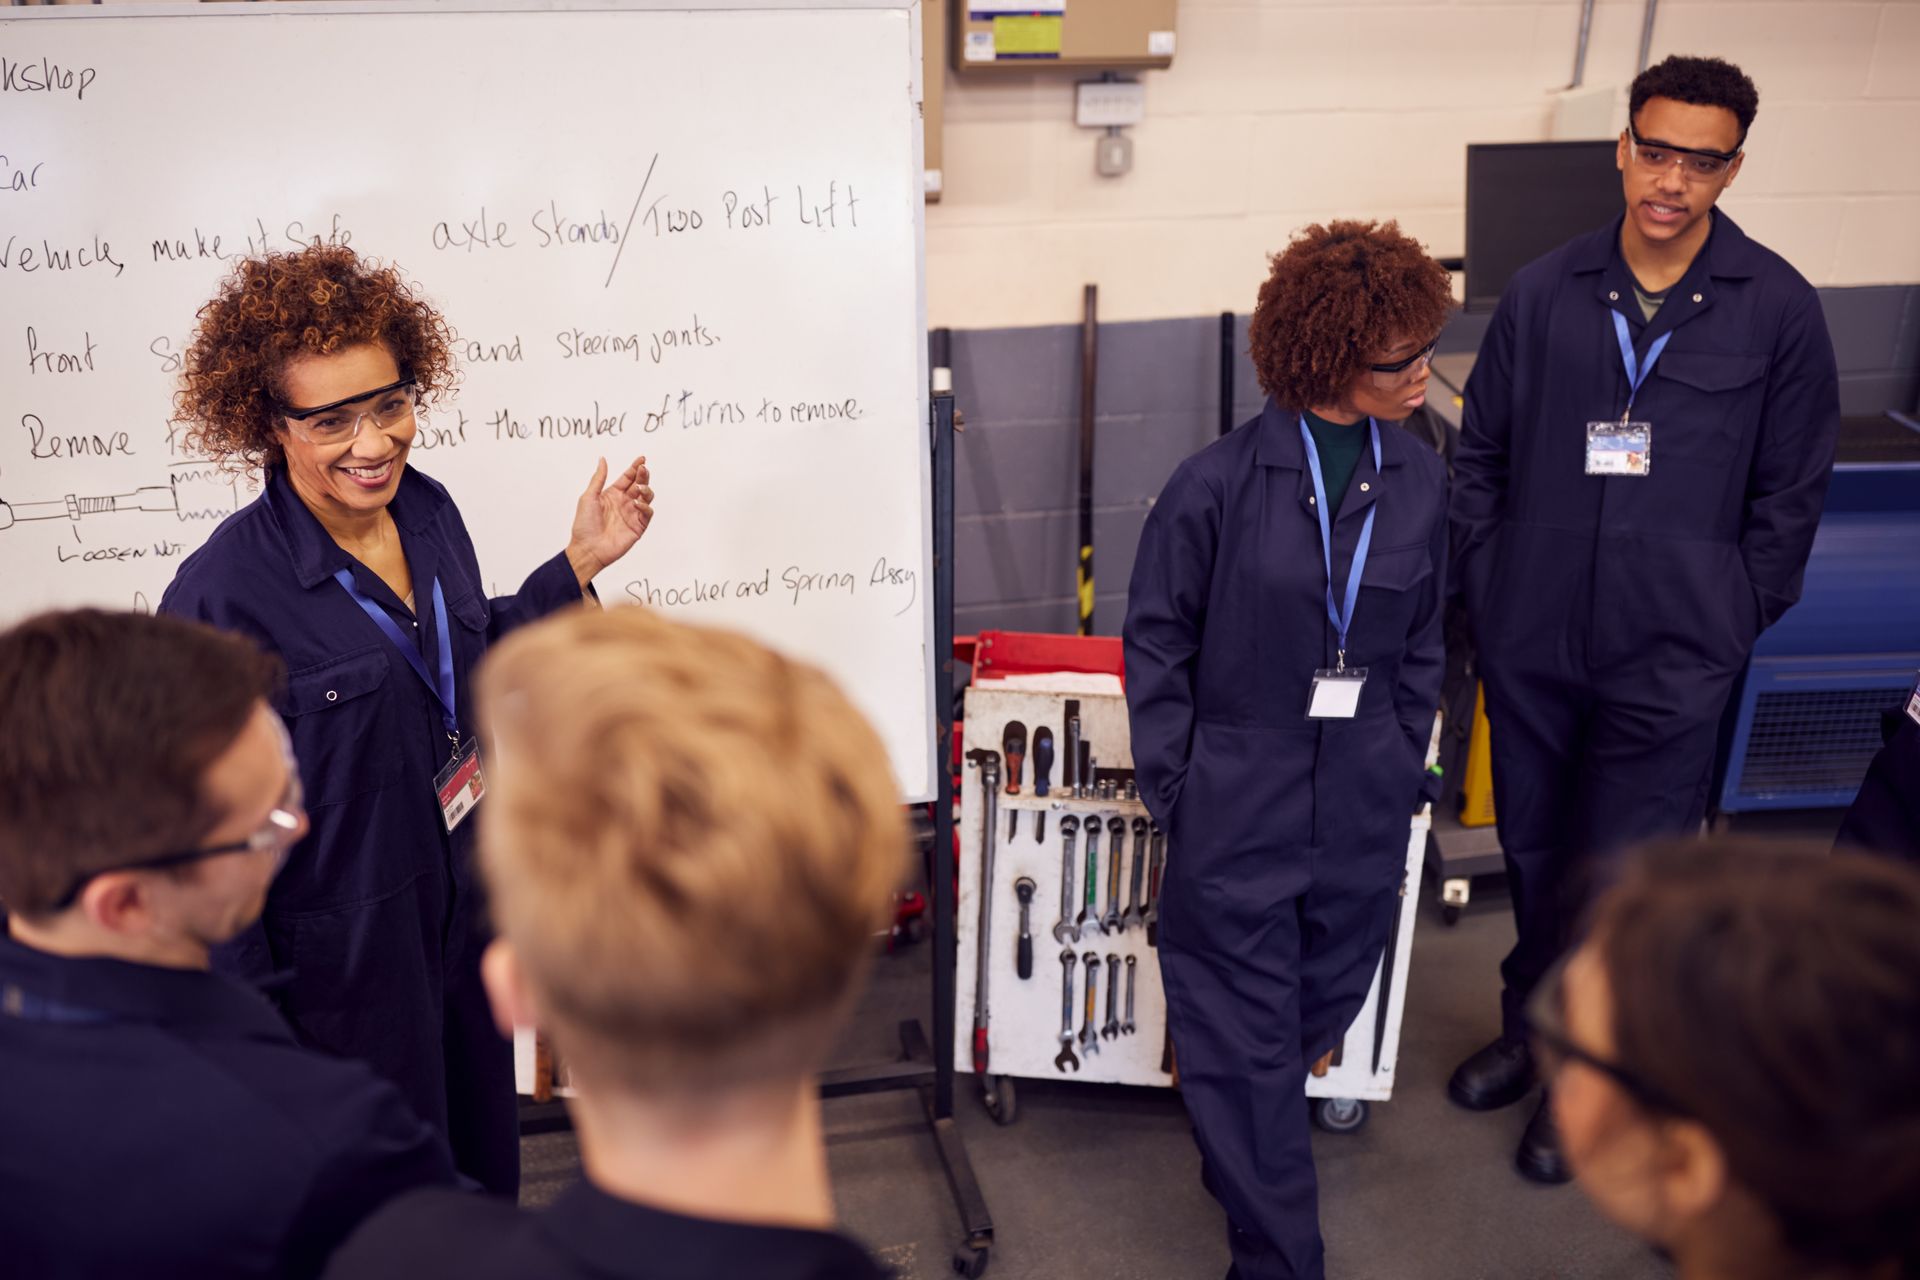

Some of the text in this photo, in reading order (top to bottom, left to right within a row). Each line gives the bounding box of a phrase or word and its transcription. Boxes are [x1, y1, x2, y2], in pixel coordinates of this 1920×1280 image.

[151, 227, 228, 262] make
[432, 206, 517, 253] axle
[721, 184, 779, 230] Post
[466, 335, 524, 363] and
[20, 413, 137, 461] Remove
[411, 408, 470, 450] ount
[484, 407, 533, 441] the
[537, 400, 628, 440] number
[643, 393, 671, 434] of
[755, 397, 782, 424] to
[790, 398, 864, 423] remove.
[624, 577, 730, 608] Shocker
[735, 567, 770, 599] and
